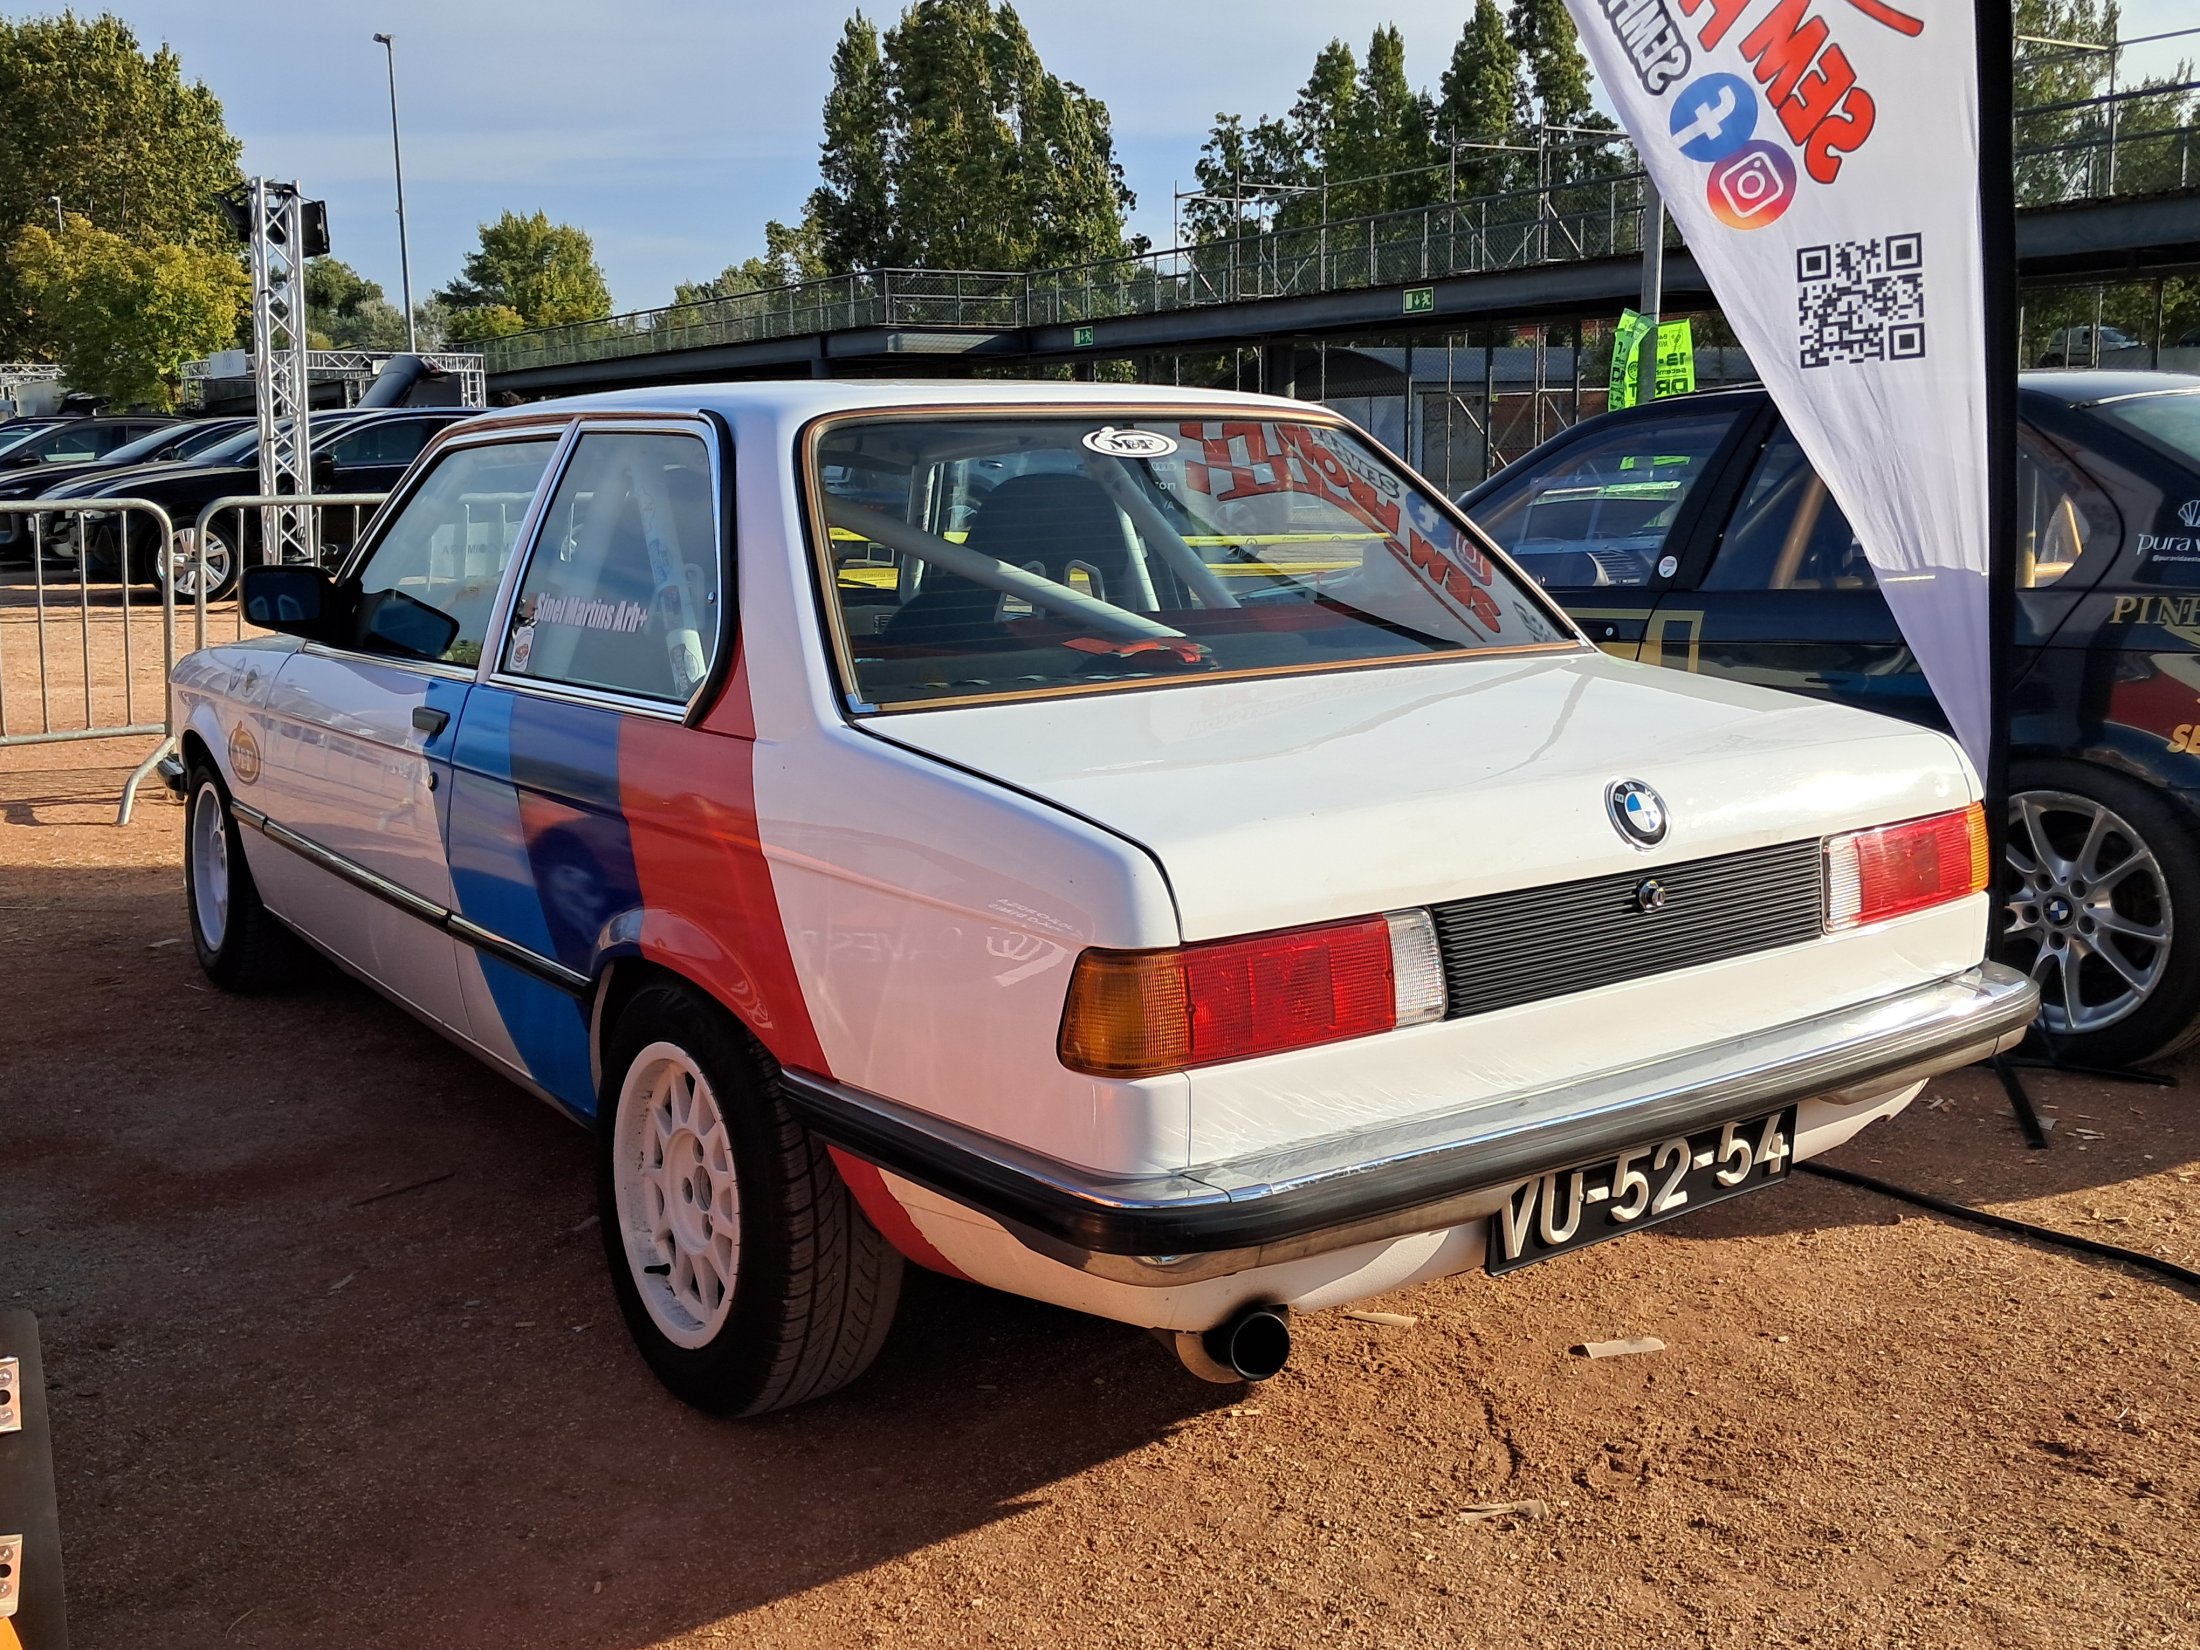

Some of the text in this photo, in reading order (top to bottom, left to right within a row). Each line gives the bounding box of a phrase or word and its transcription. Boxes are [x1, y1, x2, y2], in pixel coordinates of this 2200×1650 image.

[2136, 533, 2192, 555] pura
[1614, 782, 1656, 803] BMW
[1500, 1112, 1790, 1261] VU-52-54
